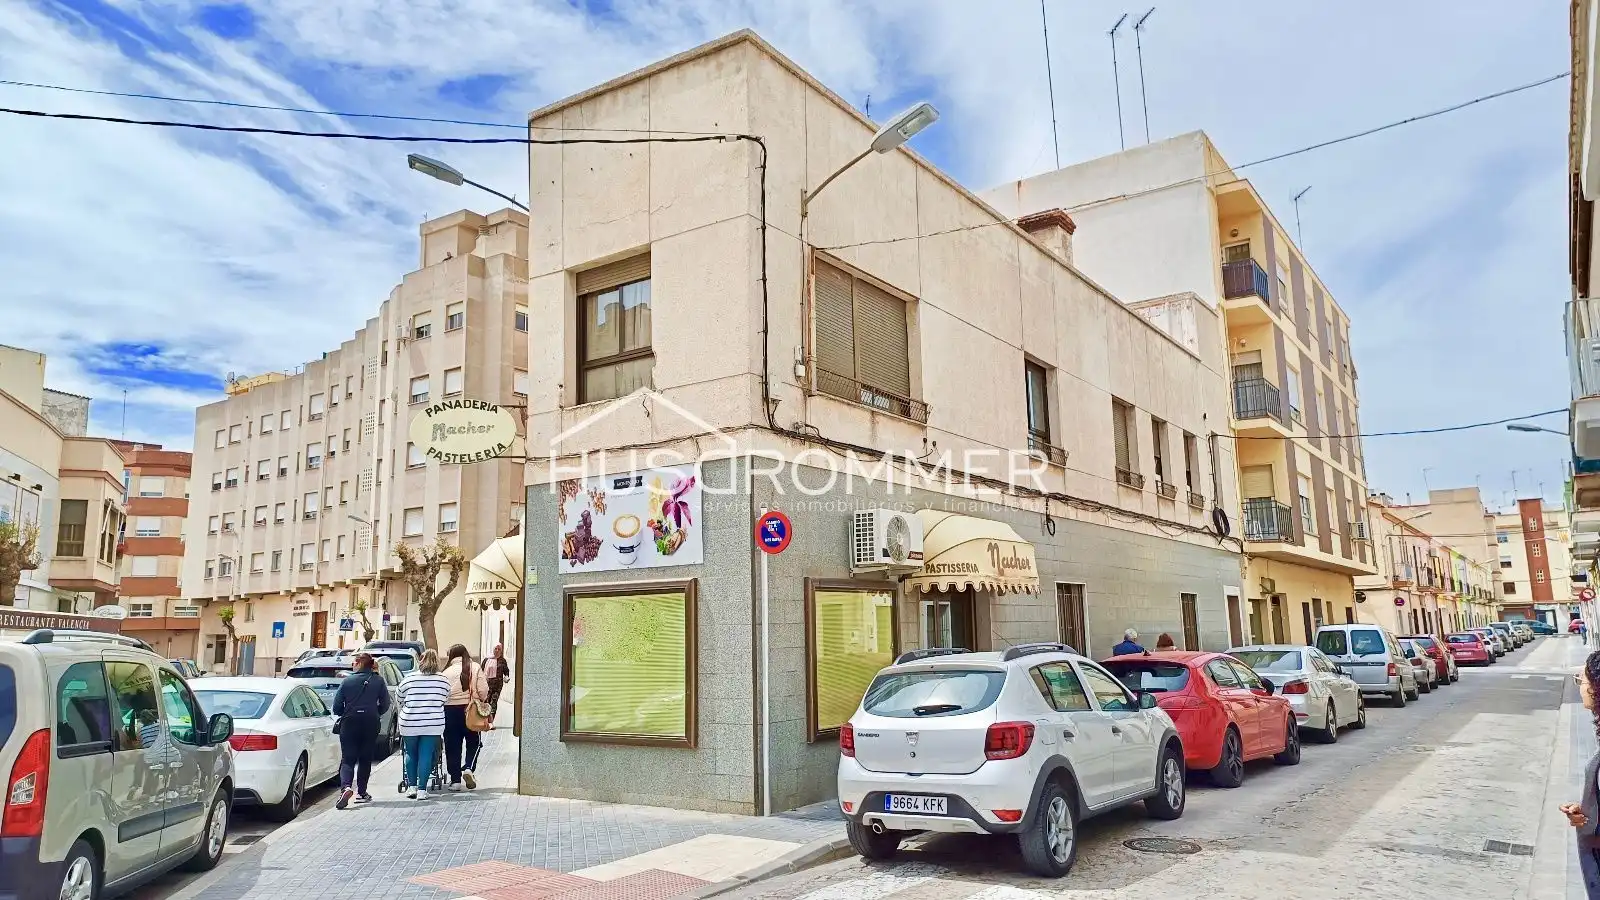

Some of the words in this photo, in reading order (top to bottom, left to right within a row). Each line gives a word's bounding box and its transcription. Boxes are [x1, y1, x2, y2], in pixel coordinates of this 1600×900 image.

[425, 400, 498, 417] PANADERIA
[427, 443, 506, 462] PASTELERIA
[986, 542, 1032, 575] Nacher
[925, 562, 980, 574] PASTISSERIA
[496, 581, 506, 590] PA
[58, 618, 90, 630] VALENCIA
[893, 796, 919, 810] 9664
[923, 798, 944, 812] KFK
